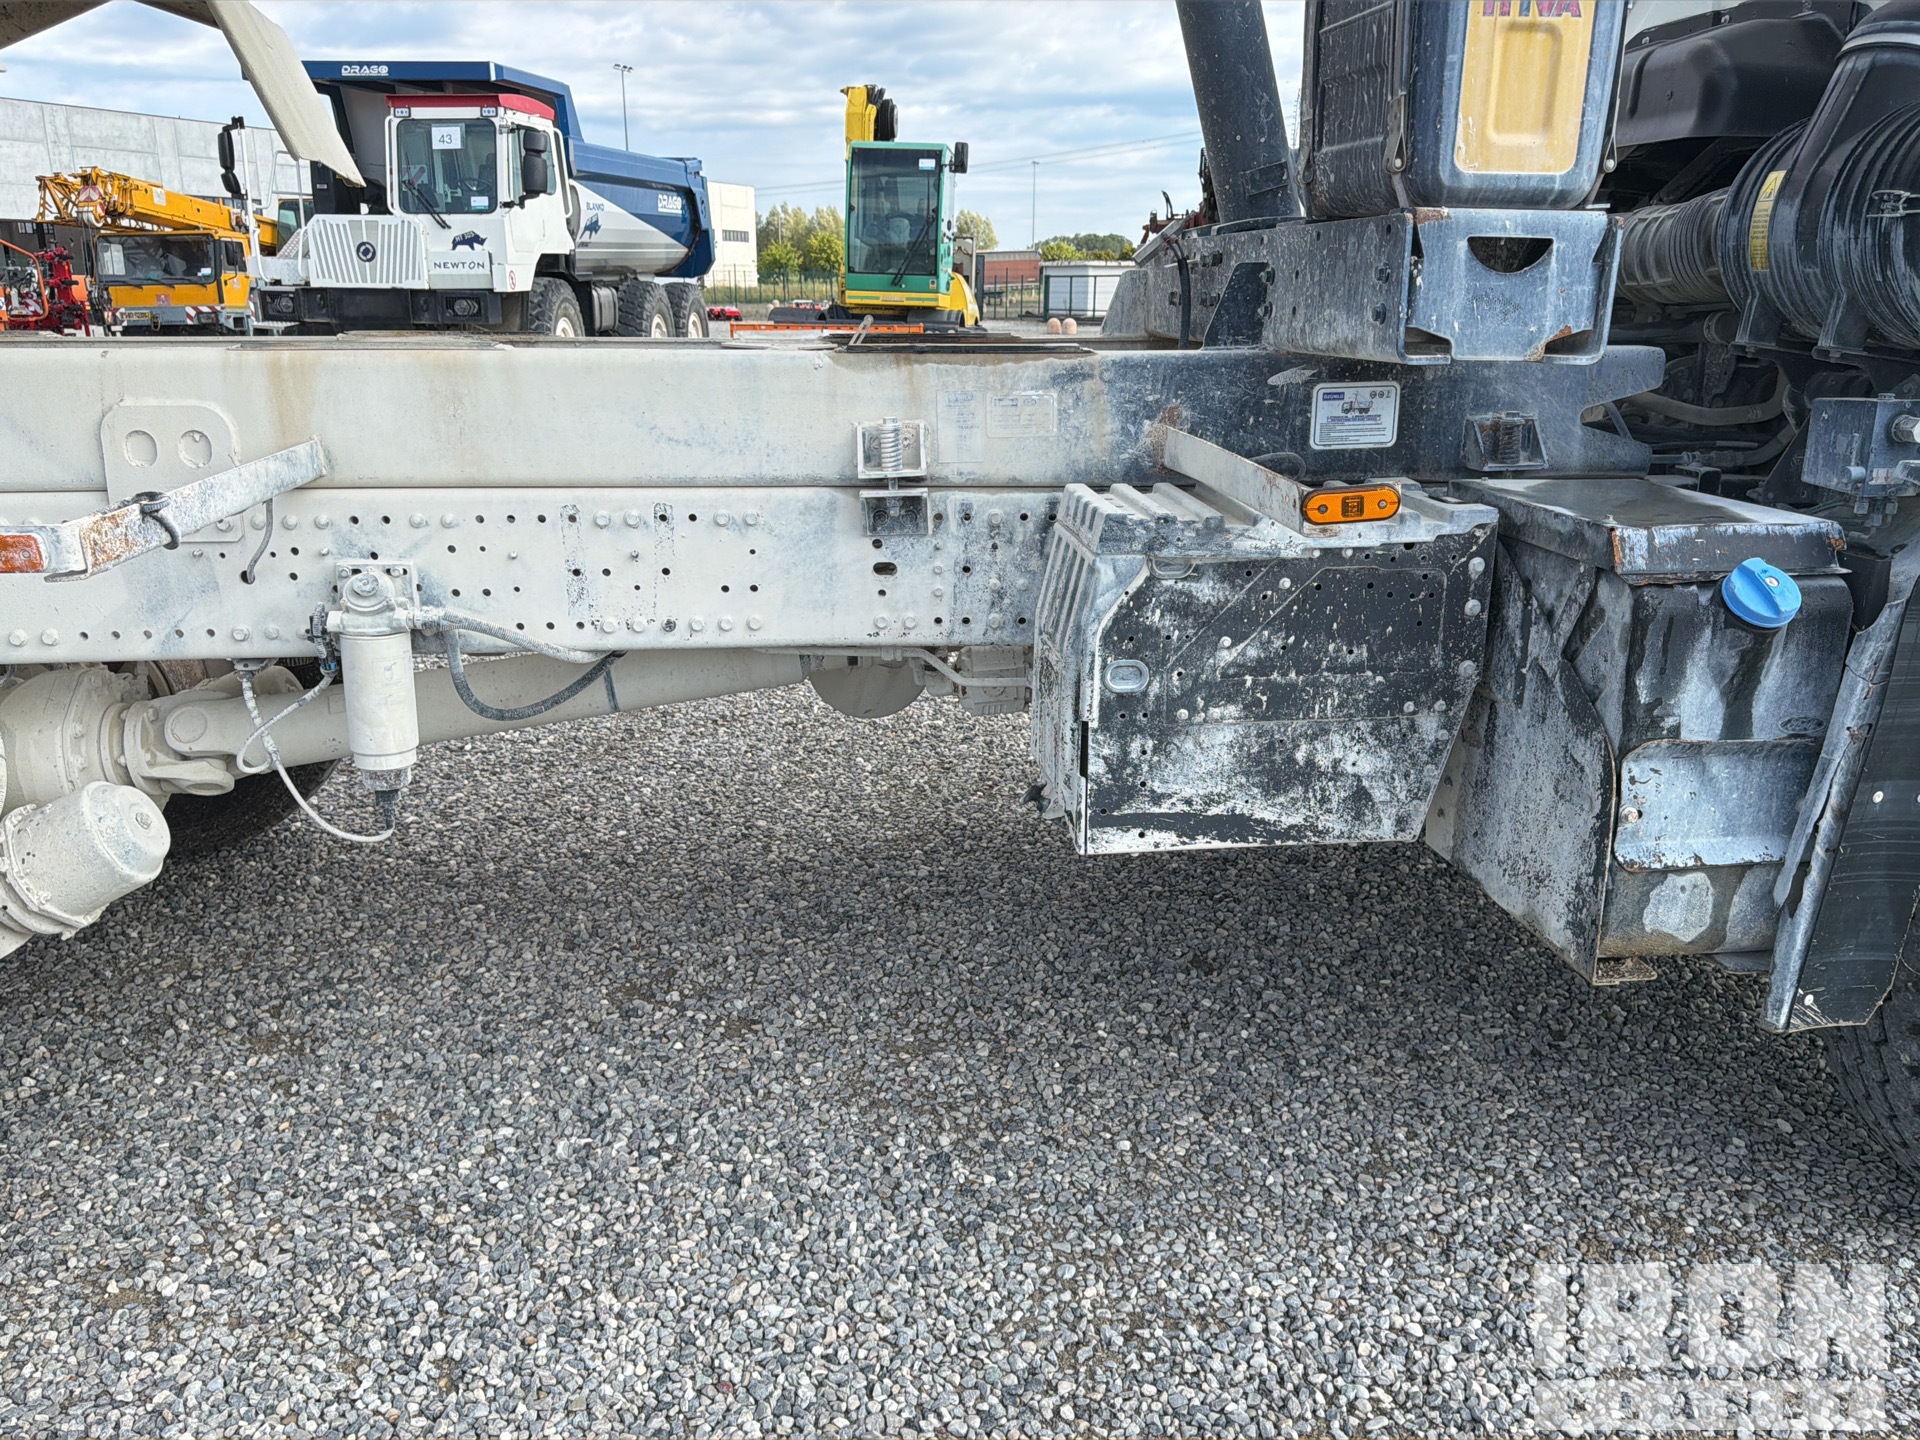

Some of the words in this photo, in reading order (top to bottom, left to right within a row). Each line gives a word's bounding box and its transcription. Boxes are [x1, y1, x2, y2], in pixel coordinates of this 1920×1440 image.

[341, 64, 389, 74] DRAGO
[438, 133, 453, 145] 43
[657, 193, 682, 210] DRAGO
[433, 261, 485, 270] NEWTON
